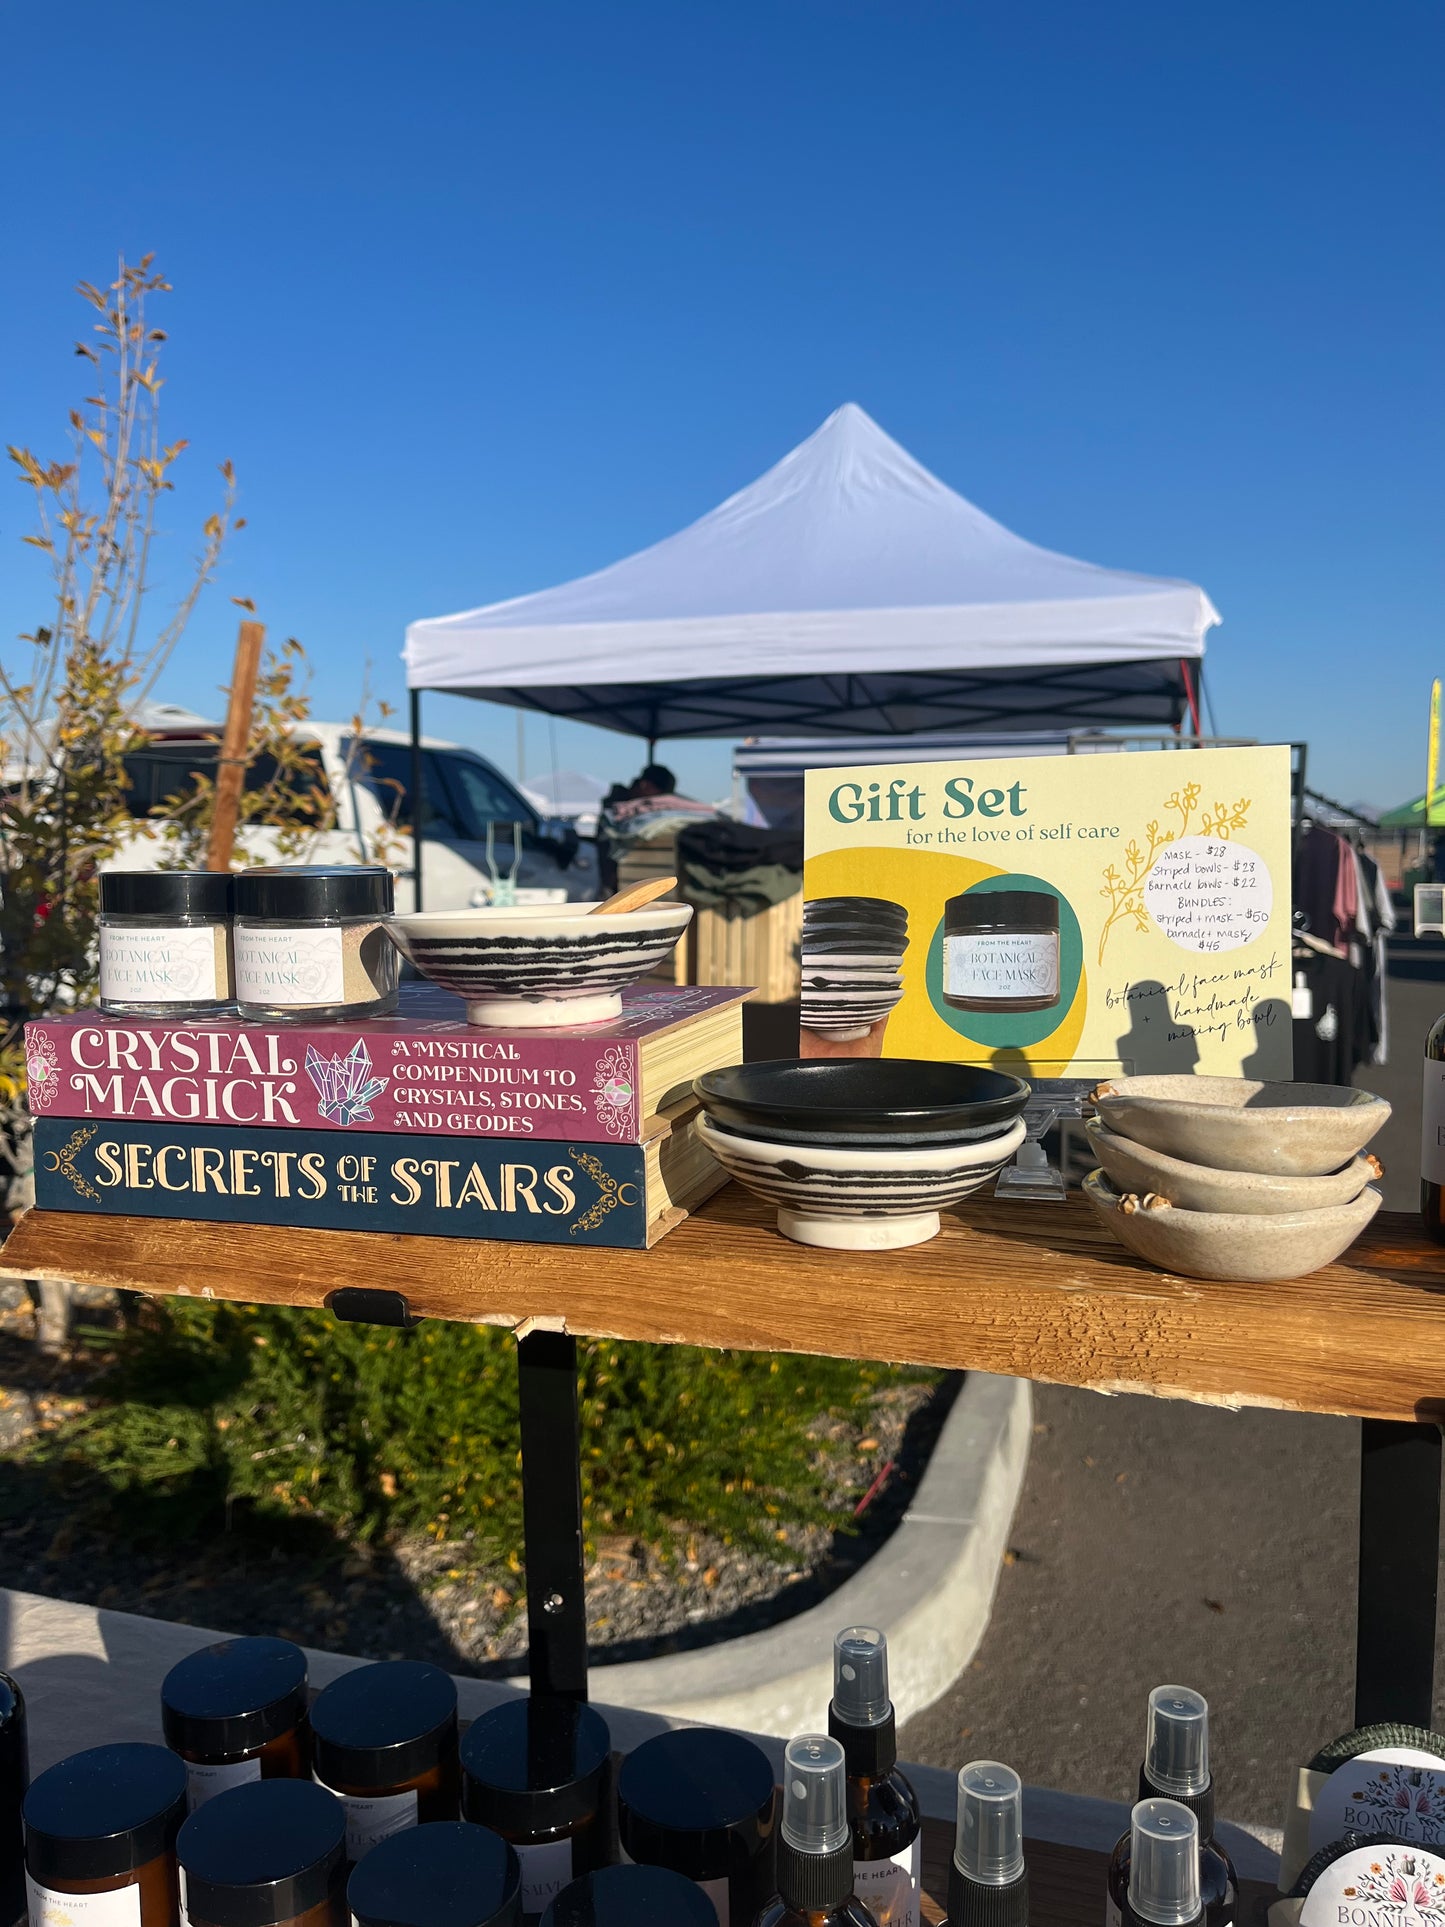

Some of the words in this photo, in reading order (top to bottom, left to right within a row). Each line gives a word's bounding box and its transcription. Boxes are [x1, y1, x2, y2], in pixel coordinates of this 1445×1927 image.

[828, 779, 926, 824] Gift
[943, 777, 1028, 819] Set
[906, 828, 932, 844] for
[938, 828, 966, 843] the
[972, 826, 1010, 842] love
[1016, 824, 1036, 840] of
[1040, 823, 1072, 840] self
[1078, 826, 1120, 839] care
[1206, 846, 1226, 857] $28
[1233, 860, 1256, 872] $28
[1233, 877, 1256, 888] $22
[1205, 913, 1234, 922] mask
[1245, 908, 1269, 922] $50
[1198, 940, 1220, 950] $45
[106, 950, 171, 962] BOTANICAL
[237, 950, 298, 964] BOTANICAL
[971, 952, 1036, 964] BOTANICAL
[106, 969, 130, 982] FACE
[136, 970, 173, 982] MASK
[240, 970, 260, 984] FACE
[264, 972, 300, 984] MASK
[973, 970, 1001, 980] FACE
[1006, 970, 1036, 980] MASK
[1106, 973, 1190, 1009] botanical
[1193, 974, 1230, 998] face
[1234, 952, 1282, 978] mask
[1174, 986, 1259, 1020] handmade
[1168, 1022, 1232, 1042] mixing
[1237, 1004, 1277, 1030] bowl
[70, 1028, 298, 1076] CRYSTAL
[391, 1040, 411, 1058] A
[412, 1041, 520, 1060] MYSTICAL
[392, 1064, 540, 1086] COMPENDIUM
[544, 1070, 576, 1088] TO
[70, 1073, 300, 1124] MAGICK
[393, 1088, 496, 1110] CRYSTALS,
[500, 1092, 588, 1114] STONES,
[393, 1110, 443, 1130] AND
[446, 1113, 534, 1134] GEODES
[94, 1140, 328, 1200] SECRETS
[336, 1154, 376, 1184] OF
[337, 1184, 379, 1204] THE
[390, 1157, 576, 1216] STARS
[1344, 1806, 1416, 1838] BONNIE
[33, 1888, 48, 1902] FROM
[48, 1898, 62, 1906] THE
[1338, 1906, 1415, 1927] BONNIE
